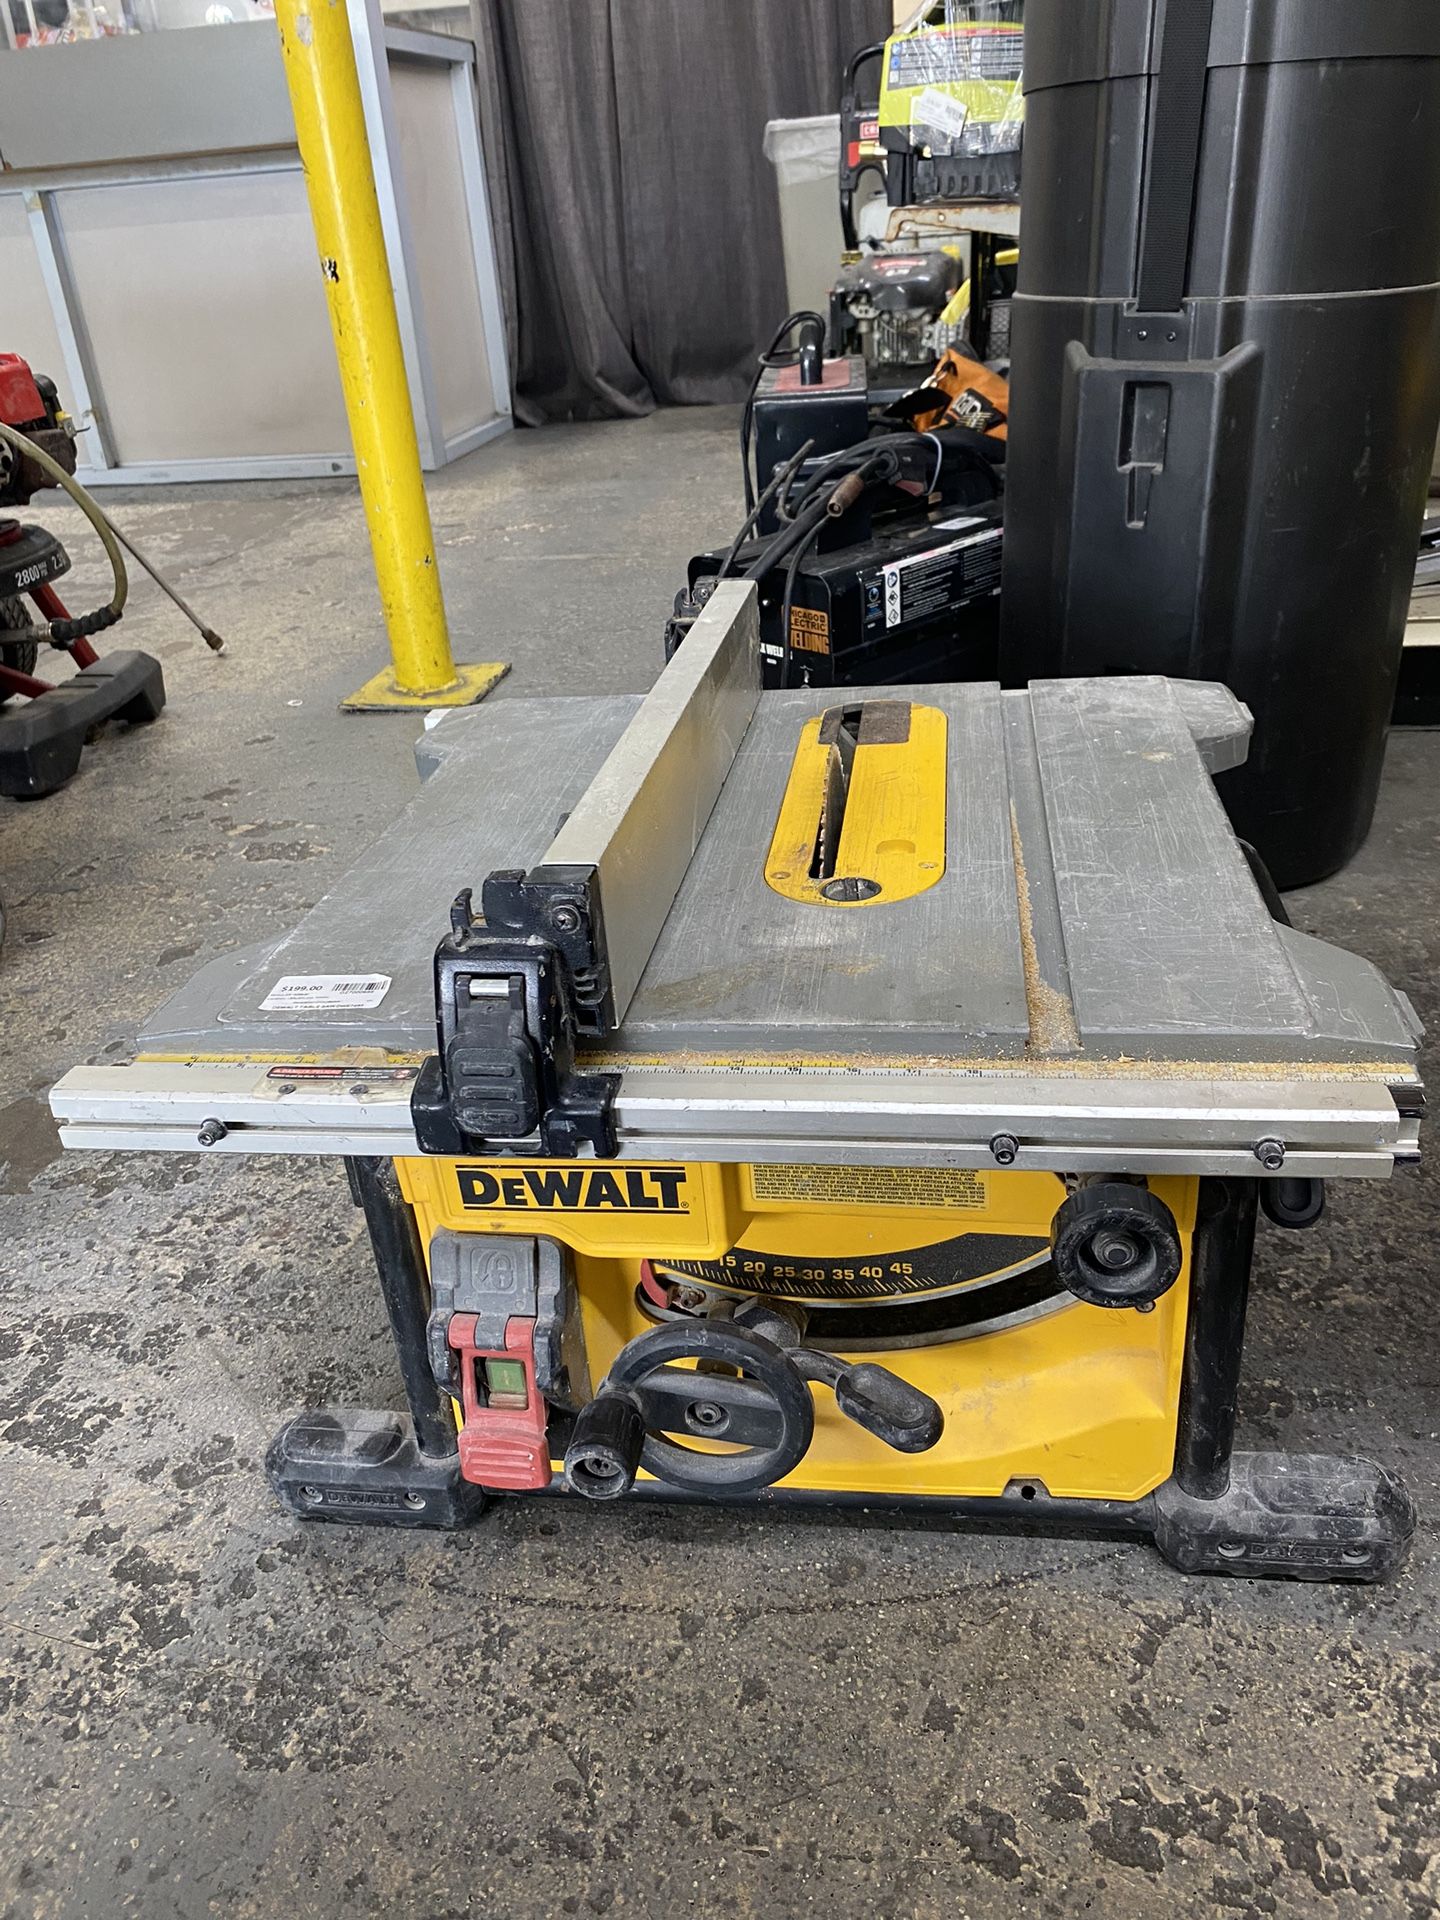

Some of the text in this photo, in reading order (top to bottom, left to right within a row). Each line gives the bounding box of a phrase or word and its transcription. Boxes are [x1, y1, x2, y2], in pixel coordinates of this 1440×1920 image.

[15, 565, 40, 587] 2800
[791, 617, 826, 632] ECTRIC
[720, 1256, 912, 1280] 15 20 25 30 35 40 45
